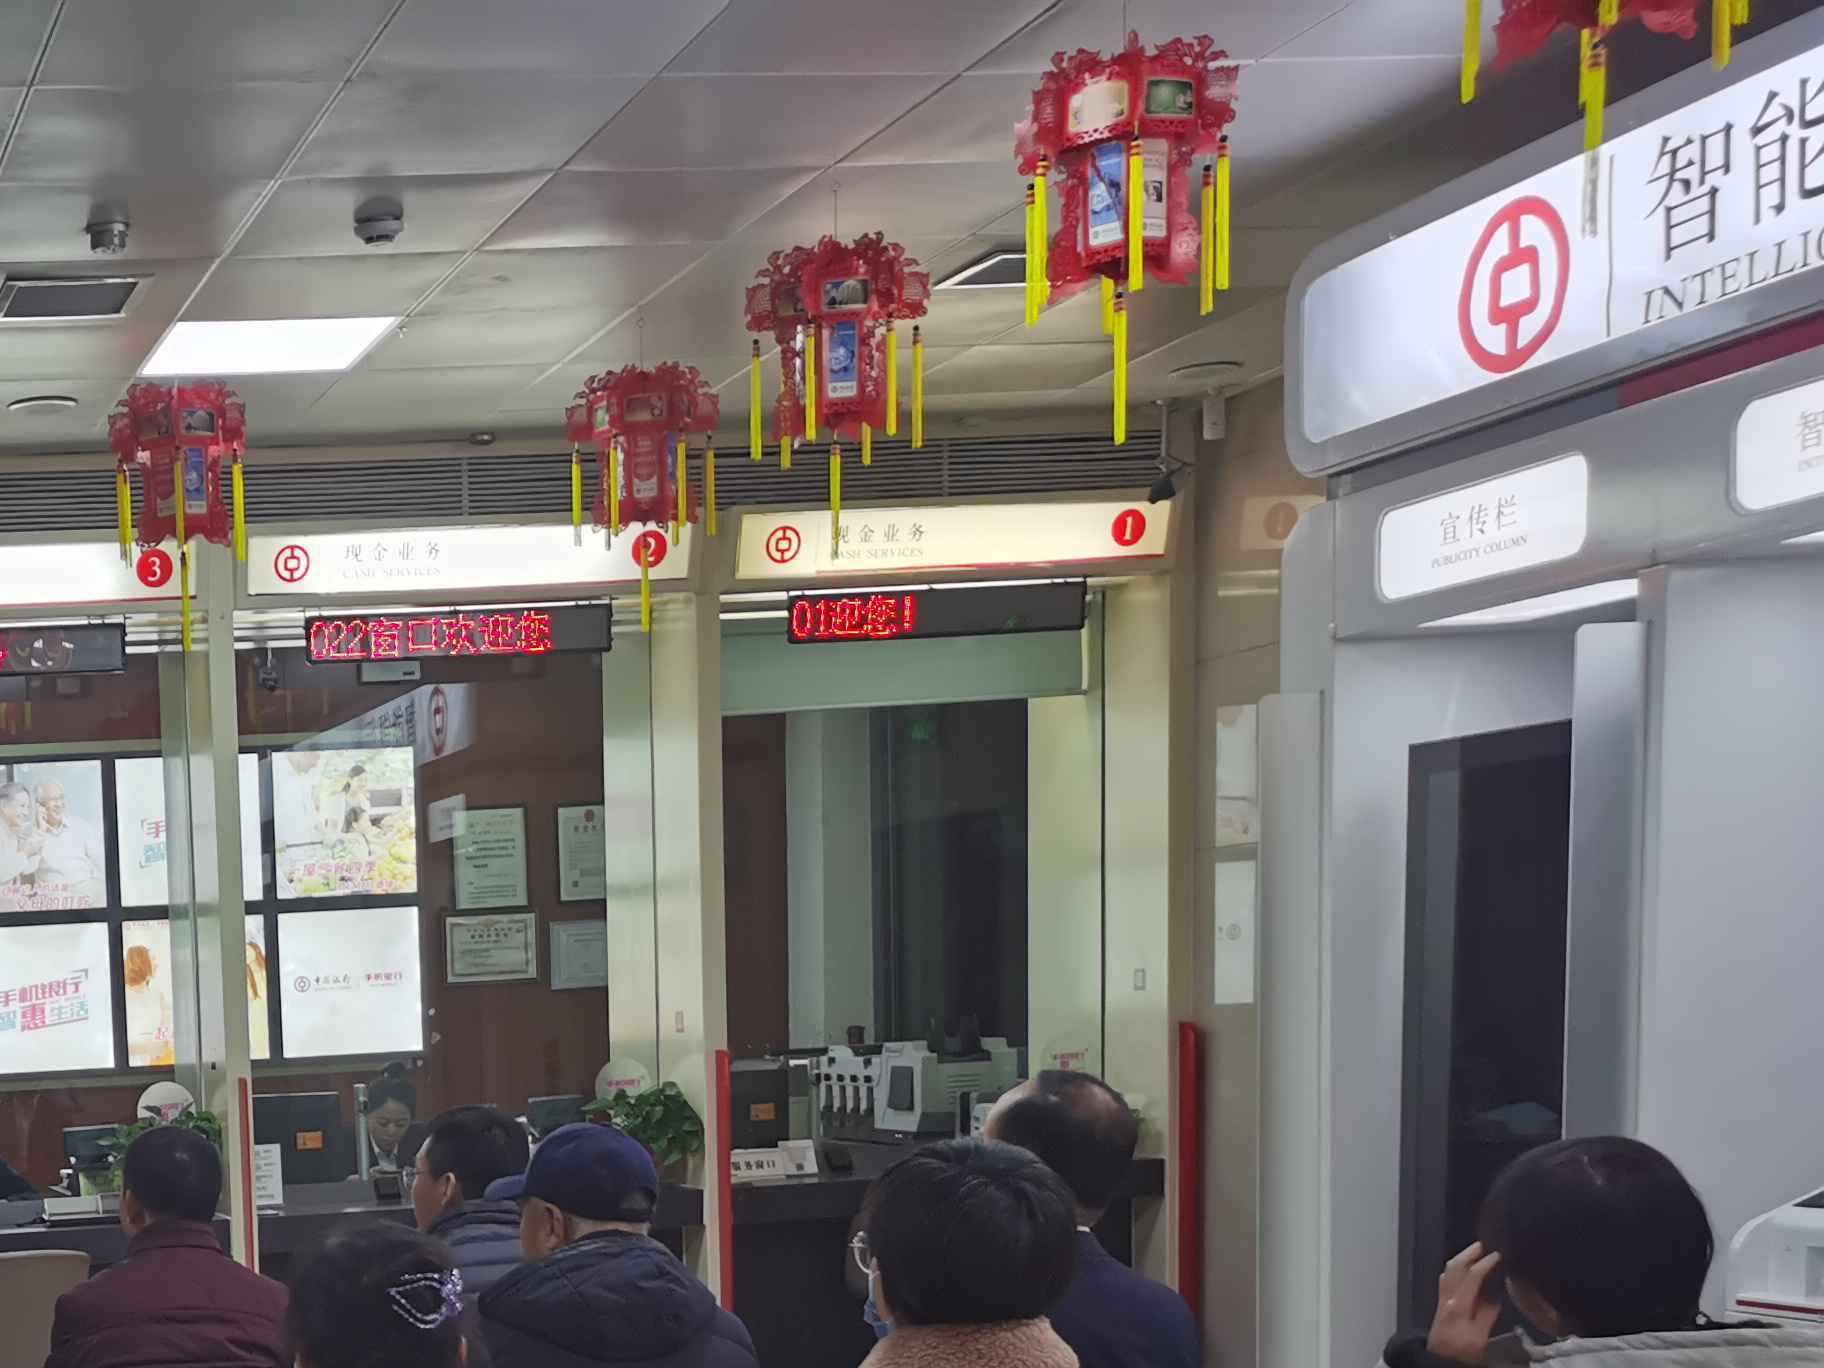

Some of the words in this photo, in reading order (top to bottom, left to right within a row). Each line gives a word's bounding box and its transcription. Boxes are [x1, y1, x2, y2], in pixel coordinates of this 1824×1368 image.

[1644, 78, 1824, 262] 智能
[1122, 518, 1135, 541] 1
[1440, 494, 1518, 546] 宣传栏
[344, 541, 442, 562] 现金业务
[643, 538, 657, 561] 2
[866, 547, 924, 559] SERVICES
[1432, 547, 1480, 568] PUBLICITY
[1483, 535, 1528, 555] COLUMN
[146, 557, 161, 579] 3
[382, 565, 441, 577] SERVICES
